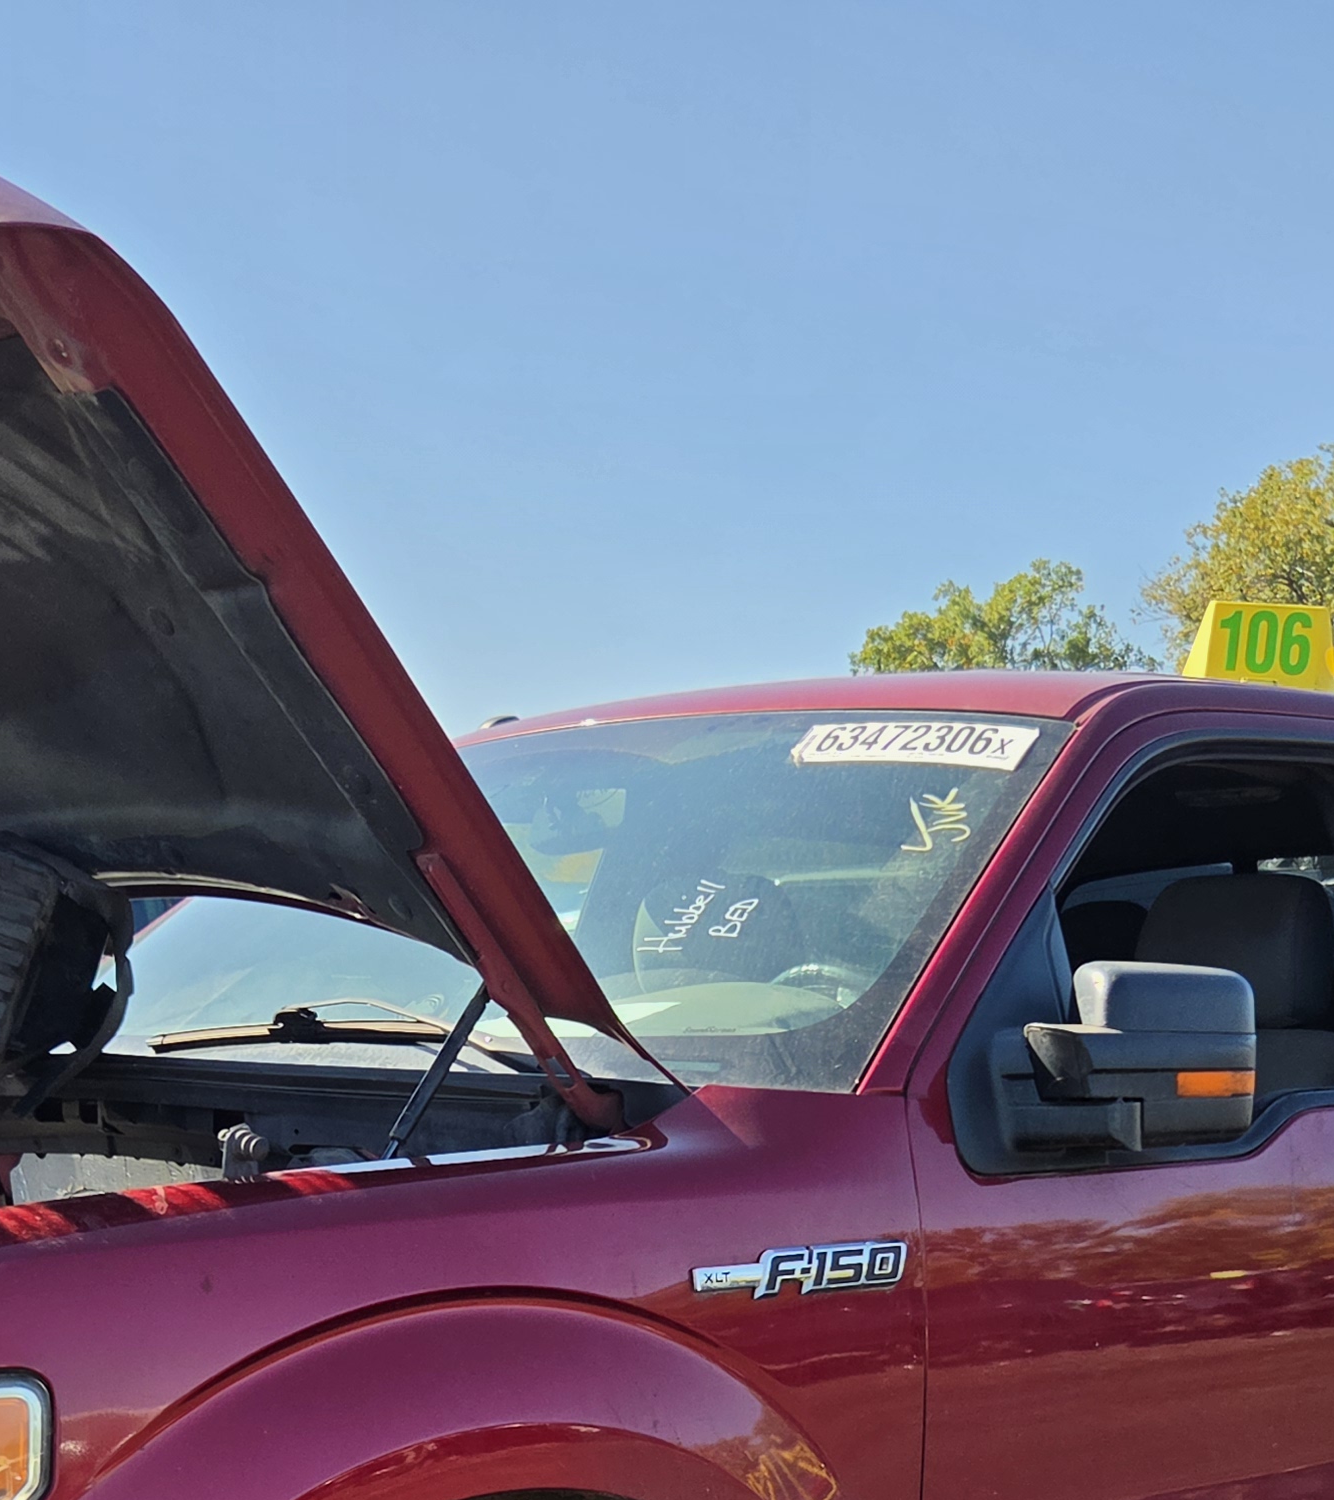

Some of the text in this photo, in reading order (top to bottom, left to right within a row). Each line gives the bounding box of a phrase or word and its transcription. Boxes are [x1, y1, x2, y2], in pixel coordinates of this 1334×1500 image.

[1219, 609, 1313, 676] 106
[636, 878, 726, 953] Hubbell
[708, 898, 759, 938] BED
[704, 1271, 731, 1284] XLT
